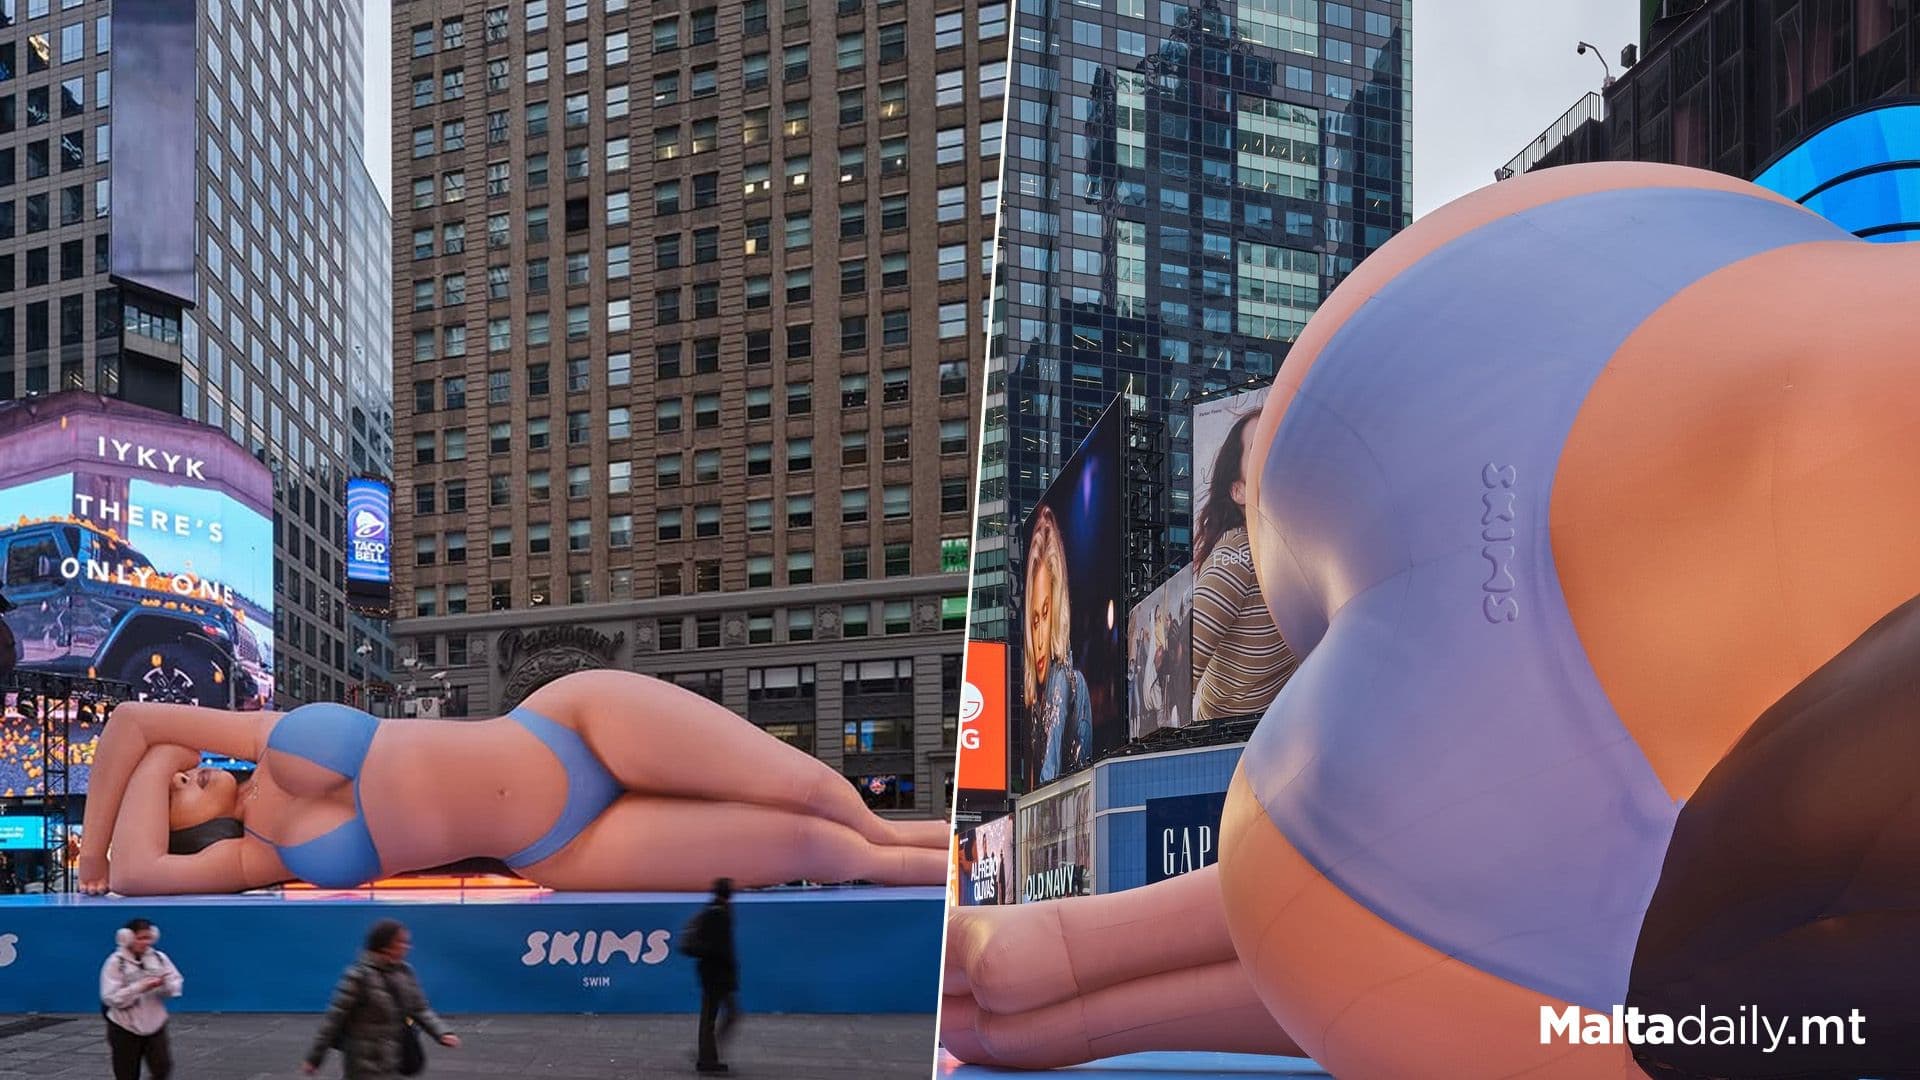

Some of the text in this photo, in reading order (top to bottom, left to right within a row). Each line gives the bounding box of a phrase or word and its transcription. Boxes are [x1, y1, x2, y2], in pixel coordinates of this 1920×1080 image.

[98, 436, 205, 481] IYKYK
[75, 494, 223, 543] THERE'S
[353, 540, 385, 553] TACO
[355, 551, 385, 563] BELL
[1213, 548, 1250, 568] Feels
[1482, 462, 1518, 624] SKIMS
[61, 557, 234, 606] ONLY ONE
[961, 728, 980, 750] G
[1163, 825, 1211, 875] GAP
[971, 856, 998, 881] ALFREDO
[1026, 863, 1074, 900] OLD NAVY
[974, 879, 995, 901] OLIVAS
[521, 930, 671, 965] SKIMS
[582, 976, 611, 988] SWIM
